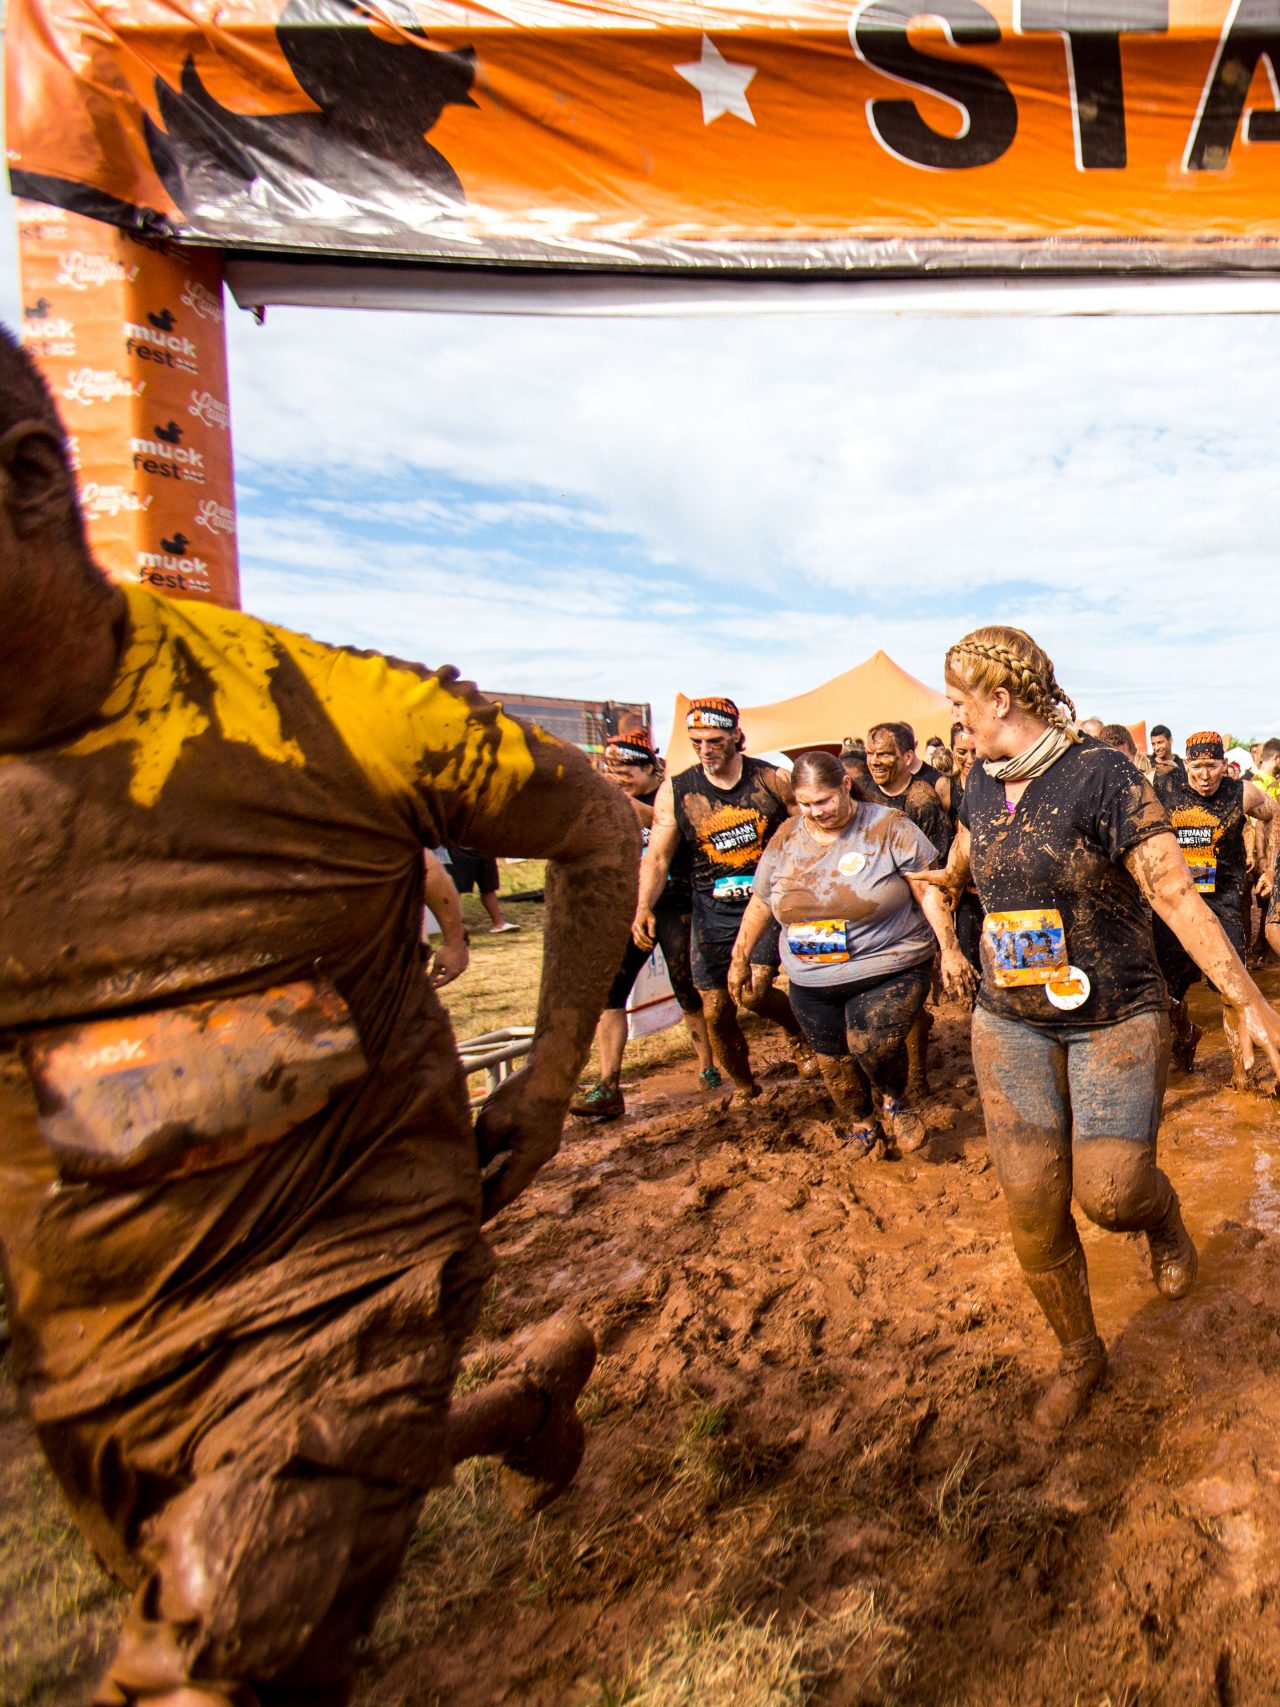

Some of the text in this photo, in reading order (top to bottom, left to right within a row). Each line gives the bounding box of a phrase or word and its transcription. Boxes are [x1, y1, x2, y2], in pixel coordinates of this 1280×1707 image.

[123, 321, 197, 358] muck
[131, 437, 205, 468] muck
[132, 454, 181, 480] fest
[137, 551, 209, 577] muck
